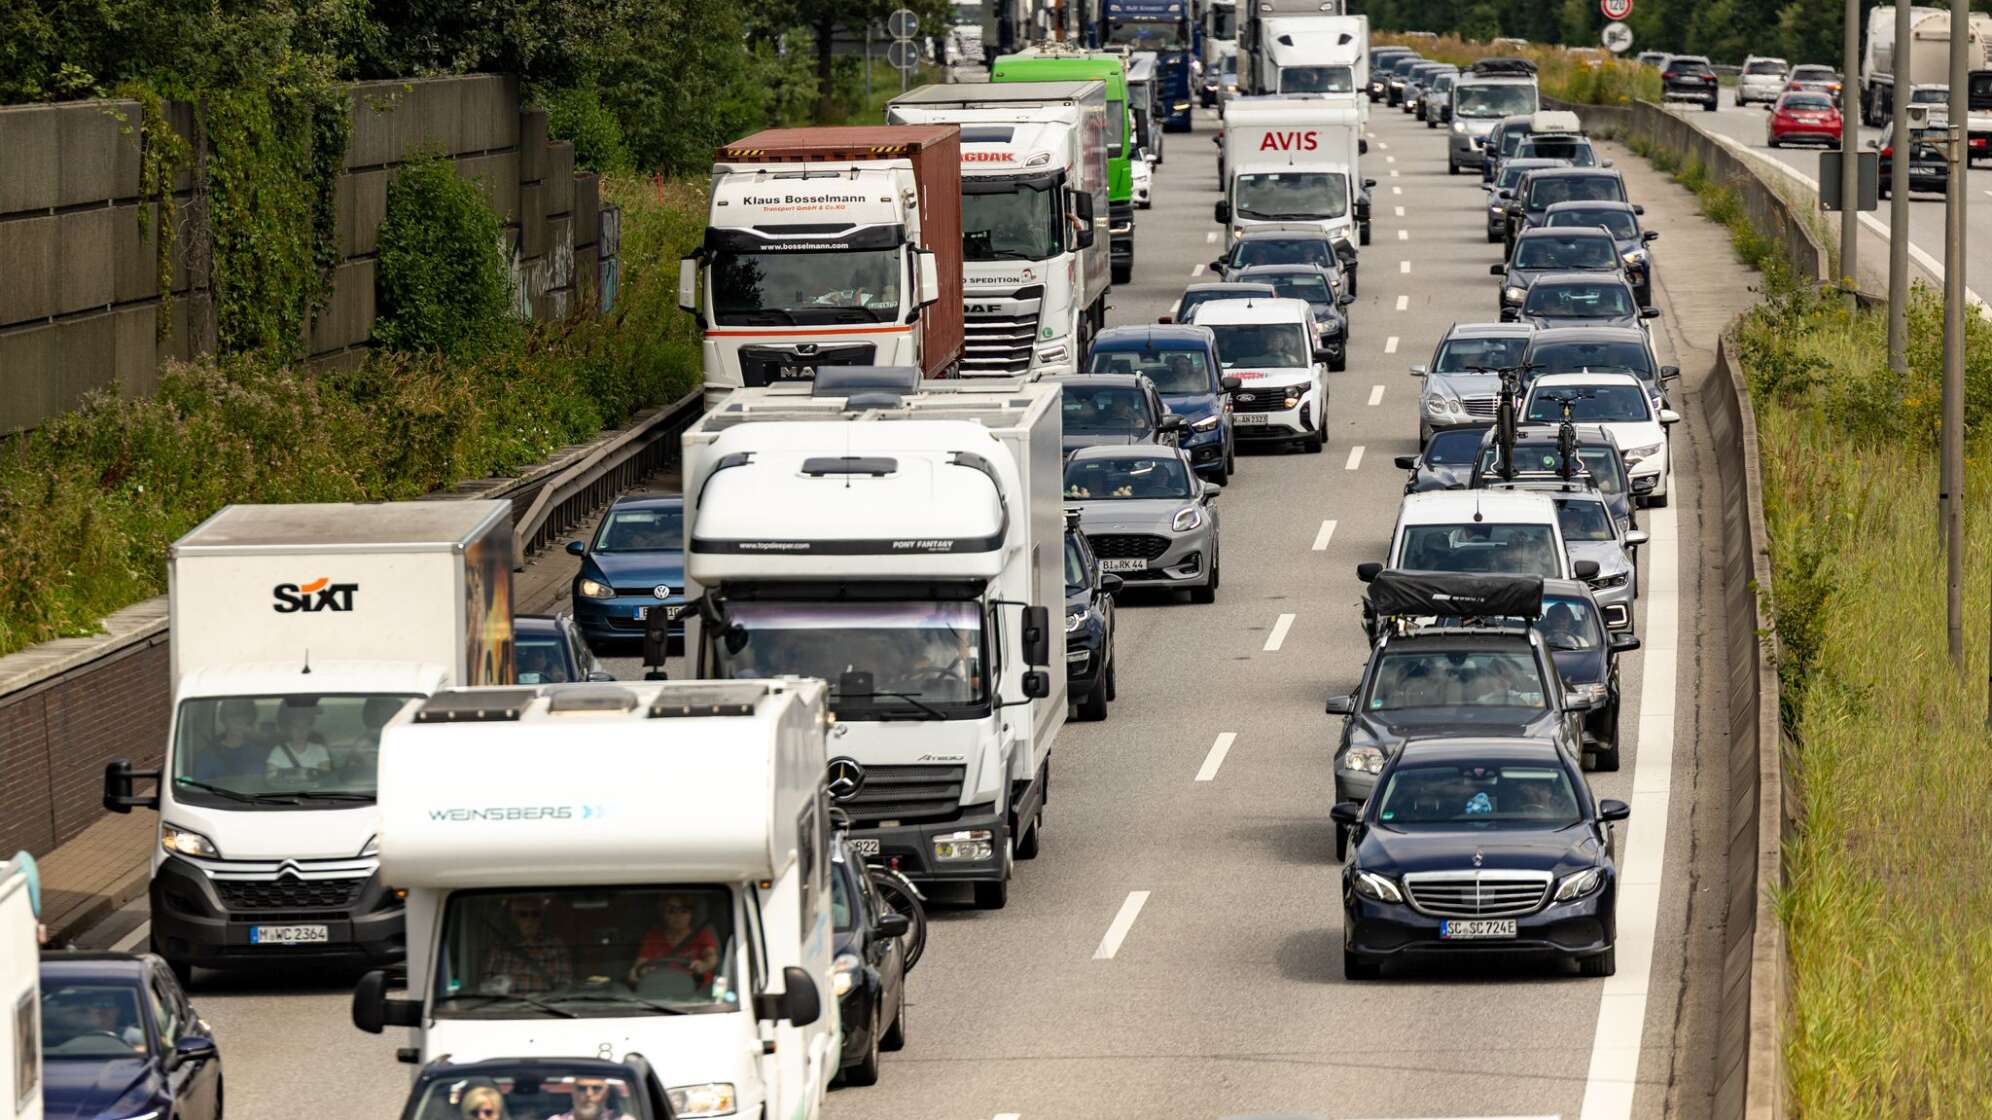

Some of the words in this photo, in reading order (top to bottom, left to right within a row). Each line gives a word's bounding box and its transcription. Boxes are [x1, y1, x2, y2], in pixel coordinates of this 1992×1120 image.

[1260, 131, 1318, 151] AVIS
[743, 197, 780, 205] Klaus
[785, 194, 866, 204] Bosselmann
[780, 366, 816, 378] MA
[893, 541, 916, 549] PONY
[917, 540, 954, 549] FANTASY
[1132, 560, 1143, 568] 44
[273, 578, 359, 613] SIXT
[429, 806, 572, 821] WEINSBERG
[1448, 922, 1461, 934] SC
[1469, 922, 1483, 934] SC
[1486, 921, 1515, 934] 724E
[260, 929, 268, 939] M
[294, 928, 325, 940] 2364
